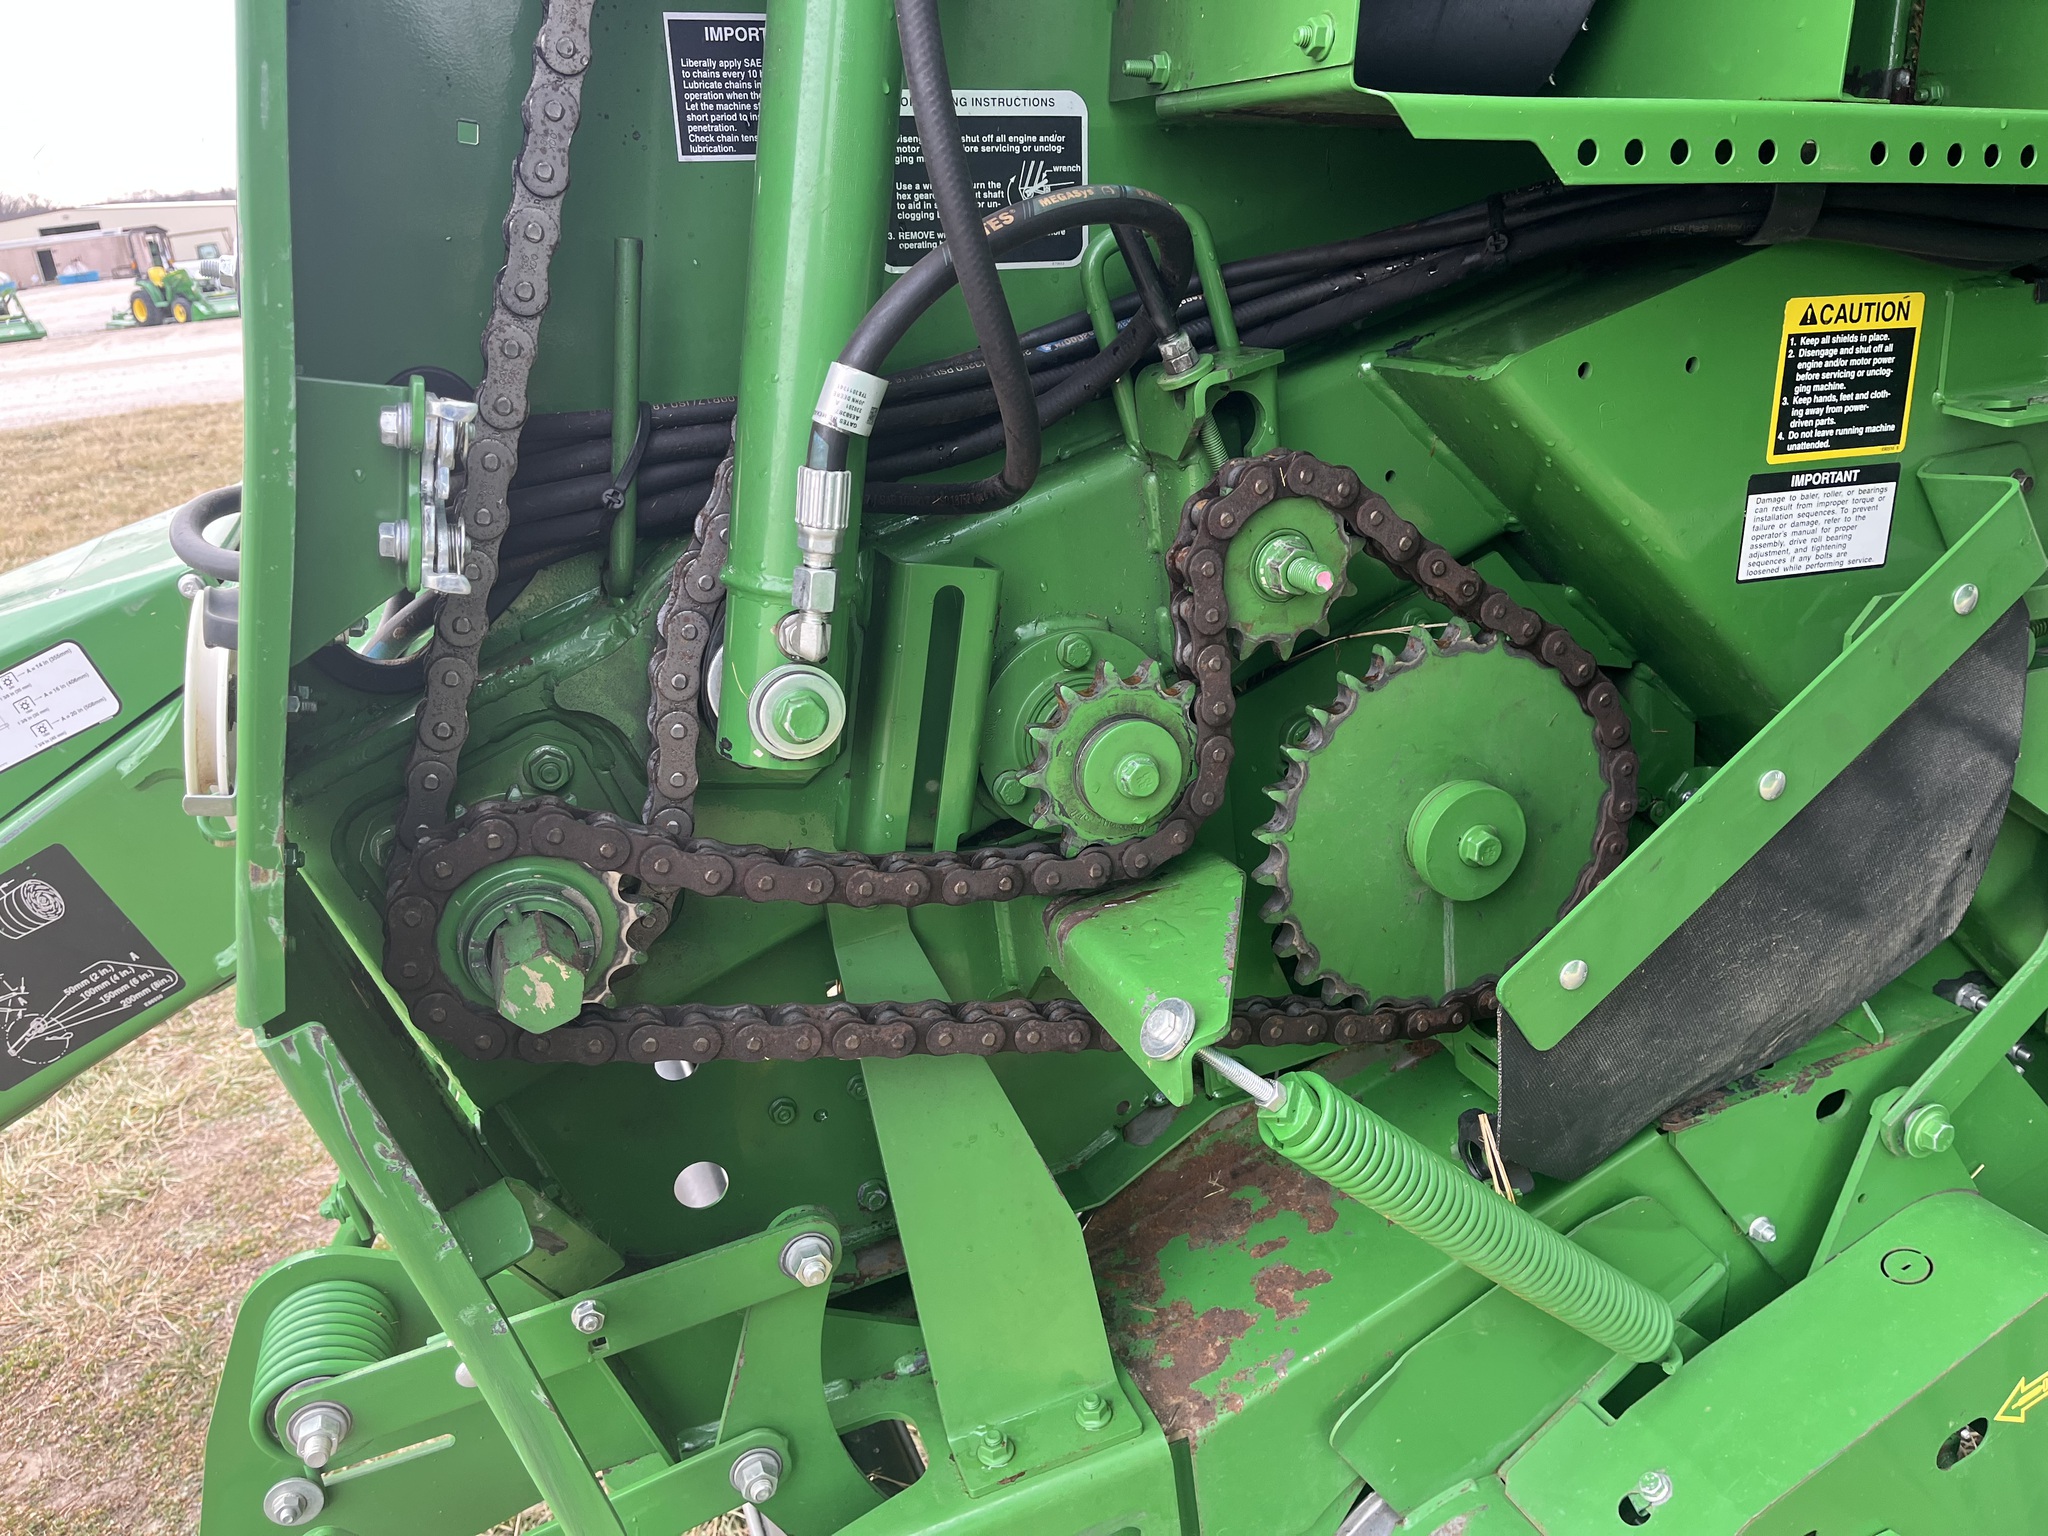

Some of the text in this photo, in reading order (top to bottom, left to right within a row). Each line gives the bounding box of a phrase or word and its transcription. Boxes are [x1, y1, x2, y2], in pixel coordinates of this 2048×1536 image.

[704, 26, 766, 42] IMPORT
[681, 58, 762, 69] Liberally apply SAE
[682, 69, 690, 78] to
[692, 68, 720, 78] chains
[722, 71, 745, 80] every
[747, 69, 758, 78] 10
[683, 80, 722, 89] Lubricate
[724, 80, 752, 89] chains
[684, 90, 724, 101] operation
[726, 91, 748, 99] when
[971, 97, 1055, 107] INSTRUCTIONS
[685, 102, 698, 110] Let
[700, 102, 714, 110] the
[716, 102, 752, 110] machine
[686, 112, 708, 121] short
[711, 112, 737, 123] period
[739, 113, 747, 121] to
[688, 123, 737, 134] penetration.
[688, 134, 740, 142] Check chain
[961, 134, 1066, 144] shut off all engine and/or
[690, 144, 736, 152] lubrication.
[981, 144, 1020, 154] servicing
[1034, 144, 1065, 154] unclog-
[894, 154, 914, 165] ging
[1053, 164, 1081, 172] wrench
[896, 182, 912, 190] Use
[988, 181, 1001, 189] the
[896, 192, 911, 200] hex
[983, 190, 1004, 199] shaft
[897, 202, 906, 210] to
[908, 202, 921, 210] aid
[898, 212, 934, 221] clogging
[888, 232, 896, 240] 3.
[898, 231, 935, 240] REMOVE
[899, 241, 938, 250] operating
[1820, 300, 1911, 325] CAUTION
[1790, 332, 1890, 346] 1. Keep all shields in place.
[1788, 344, 1894, 358] 2. Disengage and shut off all
[1797, 356, 1896, 371] engine and/or motor power
[1796, 367, 1894, 381] before servicing or unclog-
[1794, 382, 1846, 395] ging machine.
[1782, 390, 1891, 406] 3. Keep hands, feet and cloth-
[1792, 404, 1870, 418] ing away from power-
[1790, 417, 1836, 428] driven parts.
[1778, 424, 1896, 440] 4. Do not leave running machine
[1787, 439, 1830, 452] unattended.
[1790, 469, 1861, 488] IMPORTANT
[1756, 486, 1888, 506] Damage baler, roller, bearings
[1754, 496, 1874, 514] can result from improper torque
[1753, 512, 1794, 523] installation
[1797, 510, 1837, 520] sequences.
[1852, 504, 1879, 515] prevent
[1752, 514, 1867, 532] failure damage, refer the
[1750, 524, 1858, 541] operator's manual for proper
[1750, 539, 1786, 550] assembly,
[1788, 537, 1807, 546] drive
[1826, 532, 1852, 542] bearing
[1748, 542, 1847, 559] adjustment, and tightening
[1746, 556, 1874, 576] loosened while performing service.
[1747, 552, 1833, 568] sequences any bolts
[128, 951, 140, 962] A
[63, 976, 90, 997] 50mm
[80, 979, 110, 1001] 100mm
[99, 982, 130, 1003] 150mm
[119, 986, 150, 1008] 200mm
